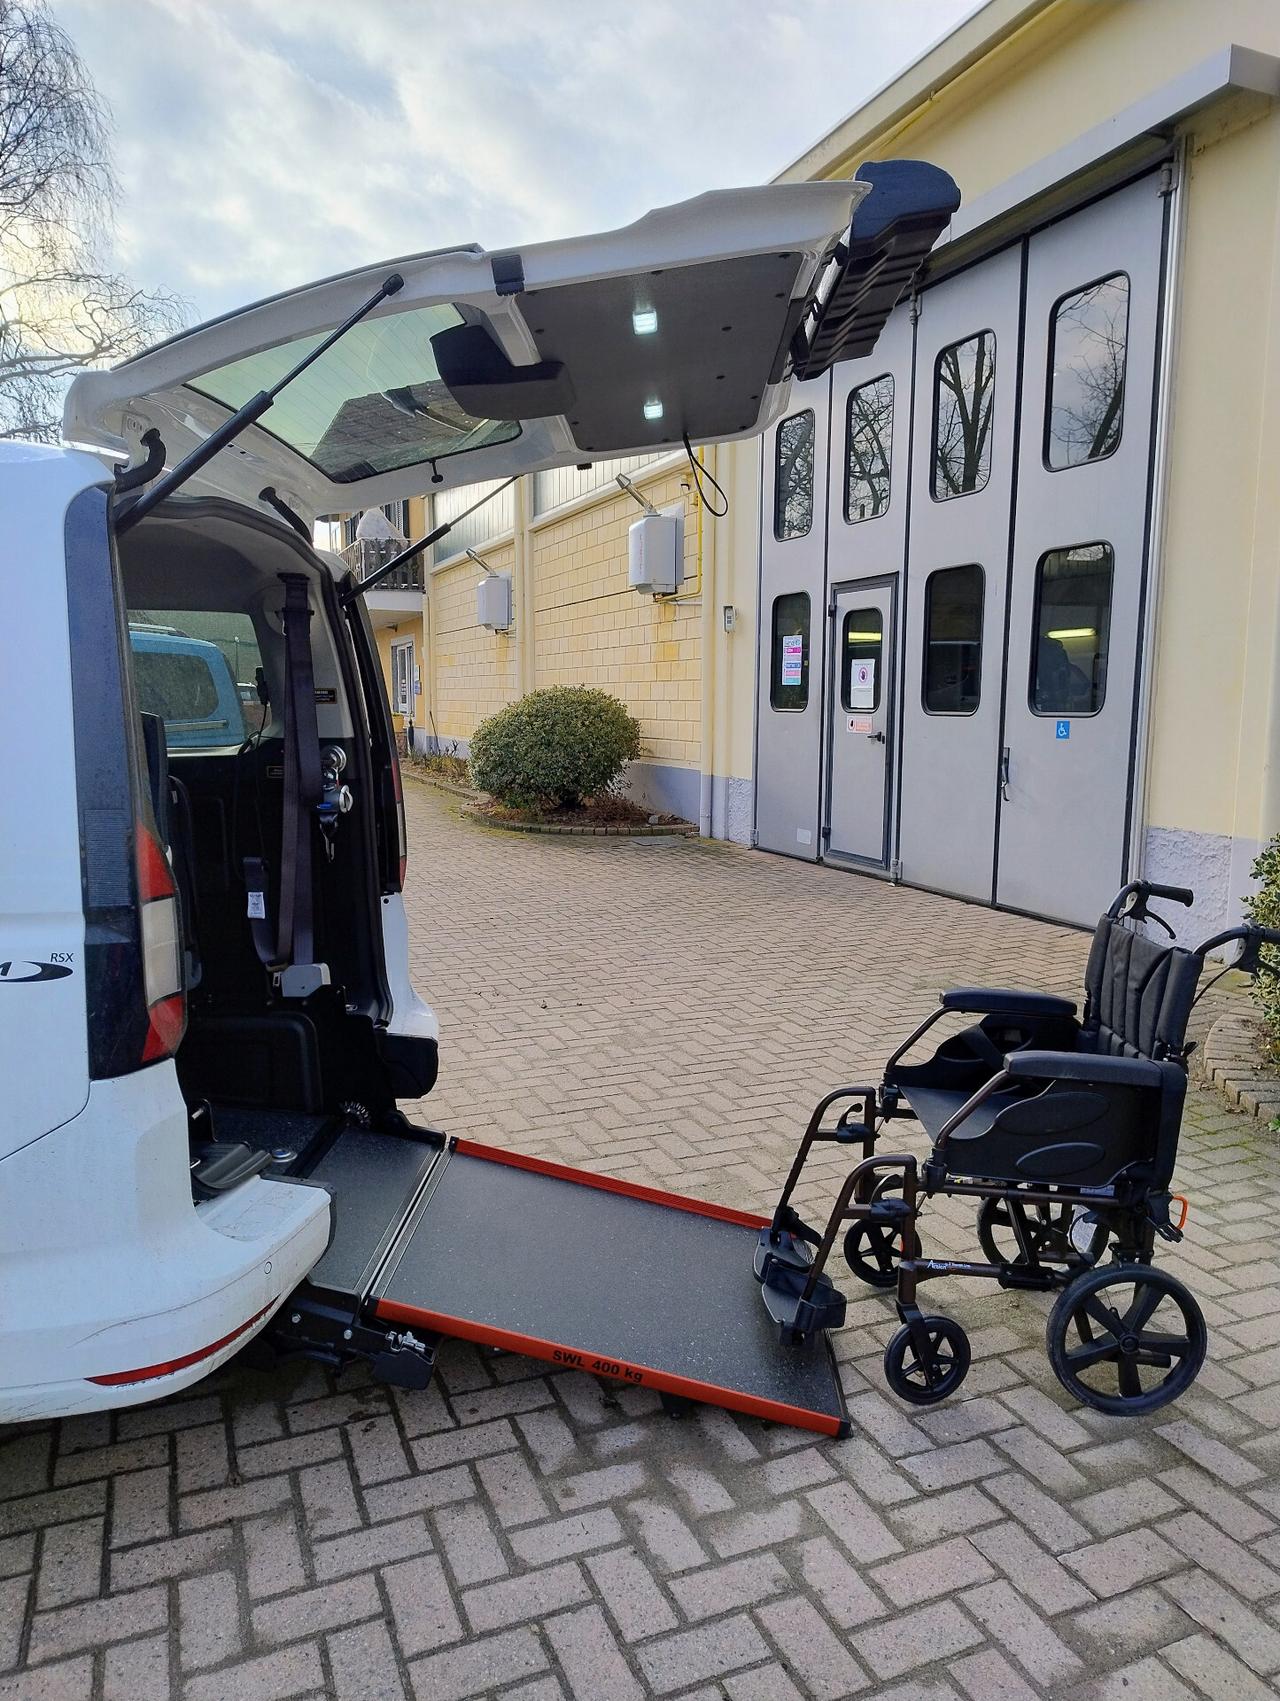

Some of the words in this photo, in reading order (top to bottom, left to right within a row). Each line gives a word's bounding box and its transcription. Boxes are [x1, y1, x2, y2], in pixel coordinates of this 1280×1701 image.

[50, 952, 75, 963] RSX
[552, 1350, 585, 1367] SWL
[592, 1360, 620, 1375] 400
[624, 1368, 644, 1383] kg
